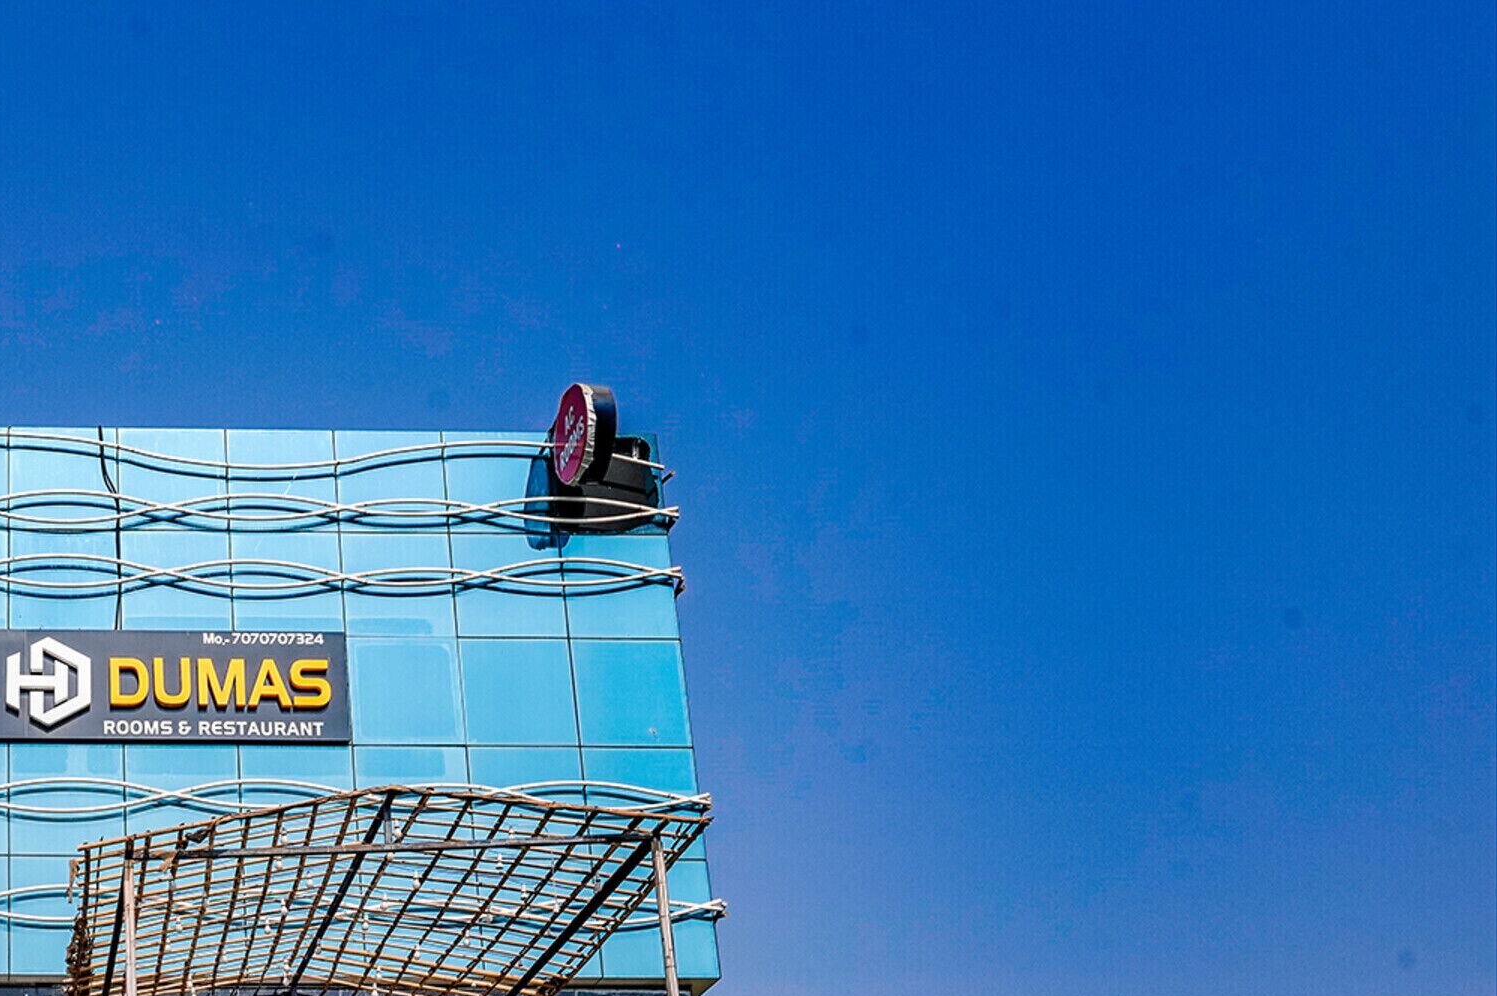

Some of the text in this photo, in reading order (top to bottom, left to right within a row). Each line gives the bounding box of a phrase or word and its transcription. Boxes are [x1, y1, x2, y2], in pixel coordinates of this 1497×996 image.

[109, 656, 332, 711] DUMAS
[103, 720, 324, 737] ROOMS & RESTAURANT
